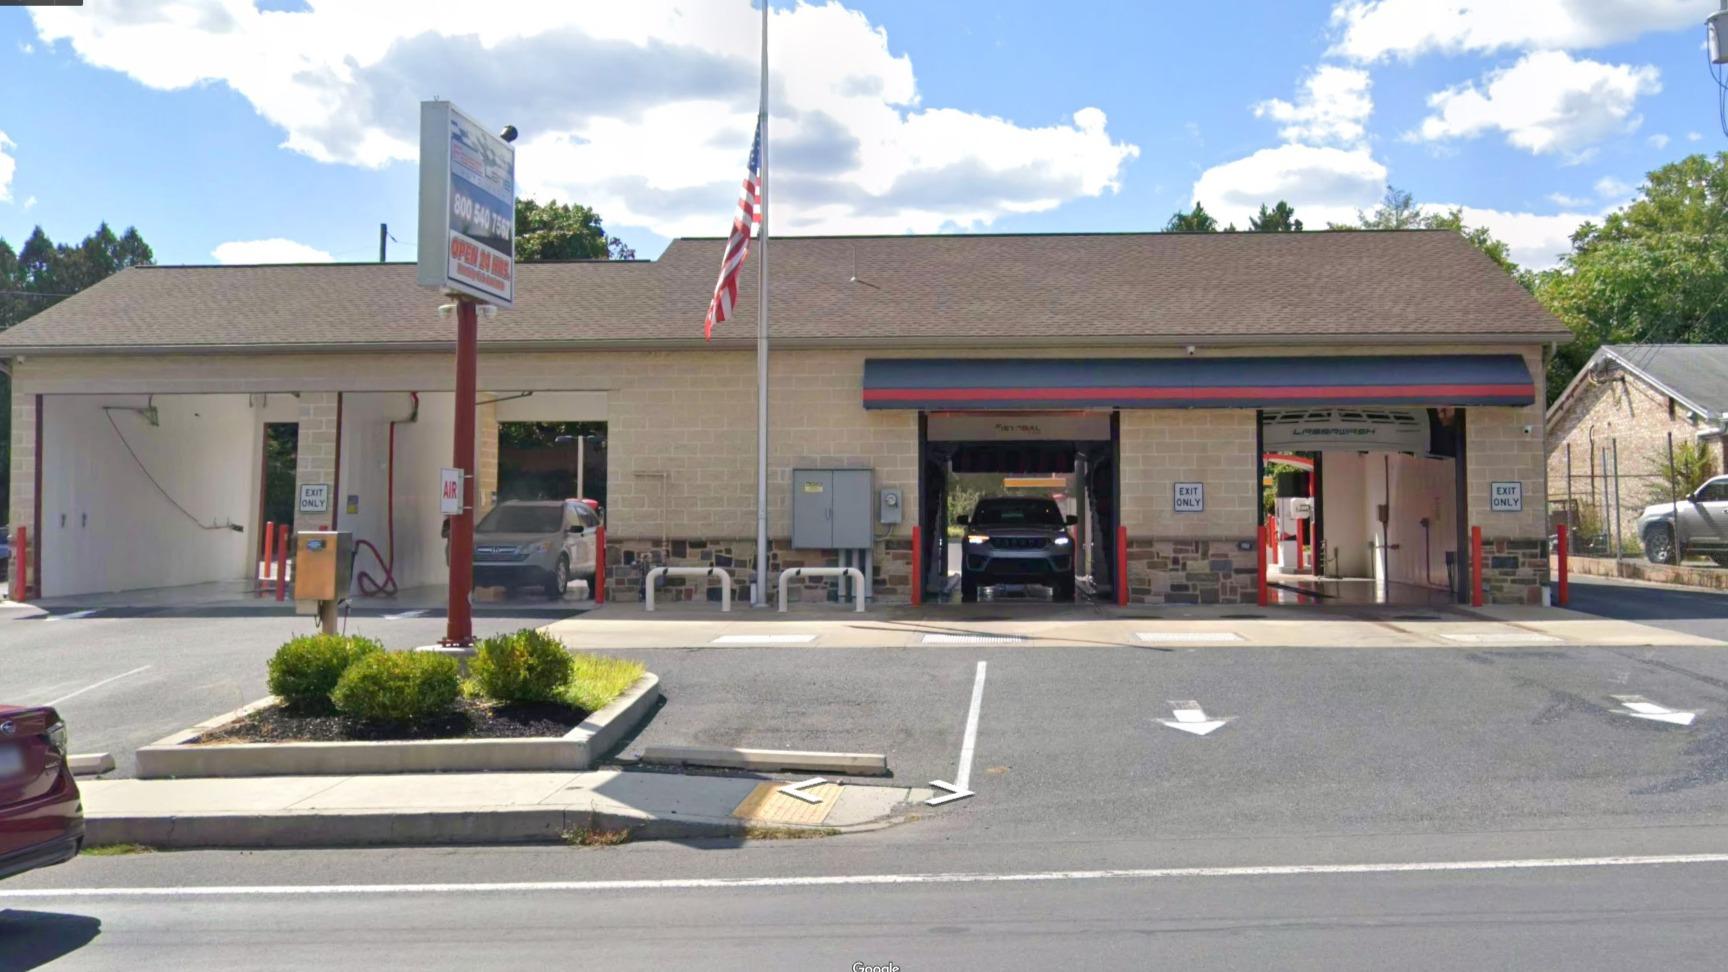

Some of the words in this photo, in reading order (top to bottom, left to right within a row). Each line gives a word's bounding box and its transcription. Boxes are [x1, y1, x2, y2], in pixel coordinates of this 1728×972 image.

[454, 193, 472, 220] 800
[474, 202, 490, 229] 540
[451, 237, 479, 268] OPEN
[305, 488, 324, 497] EXIT
[443, 480, 457, 499] AIR
[1179, 487, 1198, 496] EXIT
[1496, 486, 1517, 495] EXIT
[301, 499, 326, 508] ONLY
[1176, 498, 1201, 507] ONLY
[1493, 498, 1519, 507] ONLY
